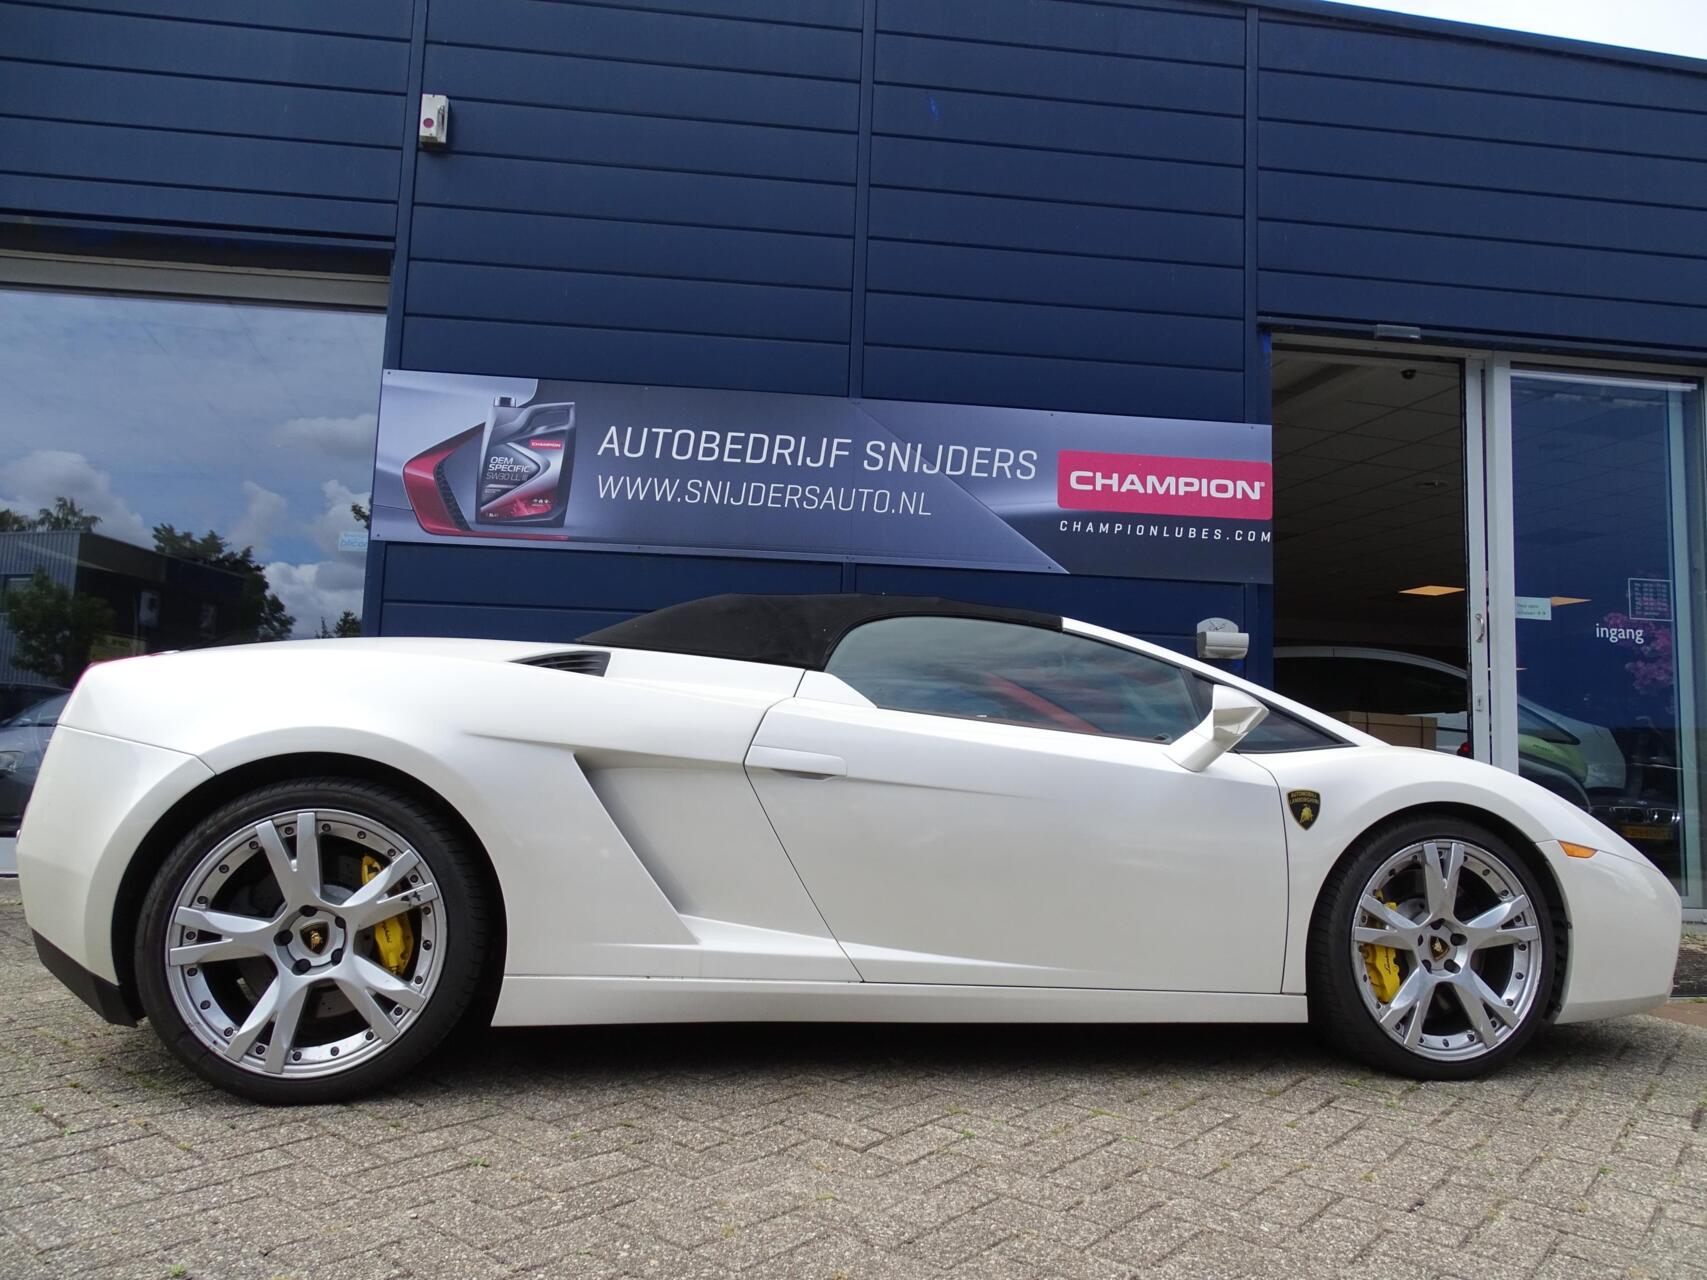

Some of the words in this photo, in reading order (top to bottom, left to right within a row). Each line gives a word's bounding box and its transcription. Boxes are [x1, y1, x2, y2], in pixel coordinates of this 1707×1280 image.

[490, 456, 514, 465] OEM
[597, 425, 852, 468] AUTOBEDRIJF
[863, 440, 1038, 480] SNIJDERS
[488, 463, 531, 473] SPECIFIC
[597, 474, 932, 516] WWW.SNIJDERSAUTO.NL
[1059, 520, 1272, 543] CHAMPIONLUBES.COM
[1595, 623, 1645, 645] ingang
